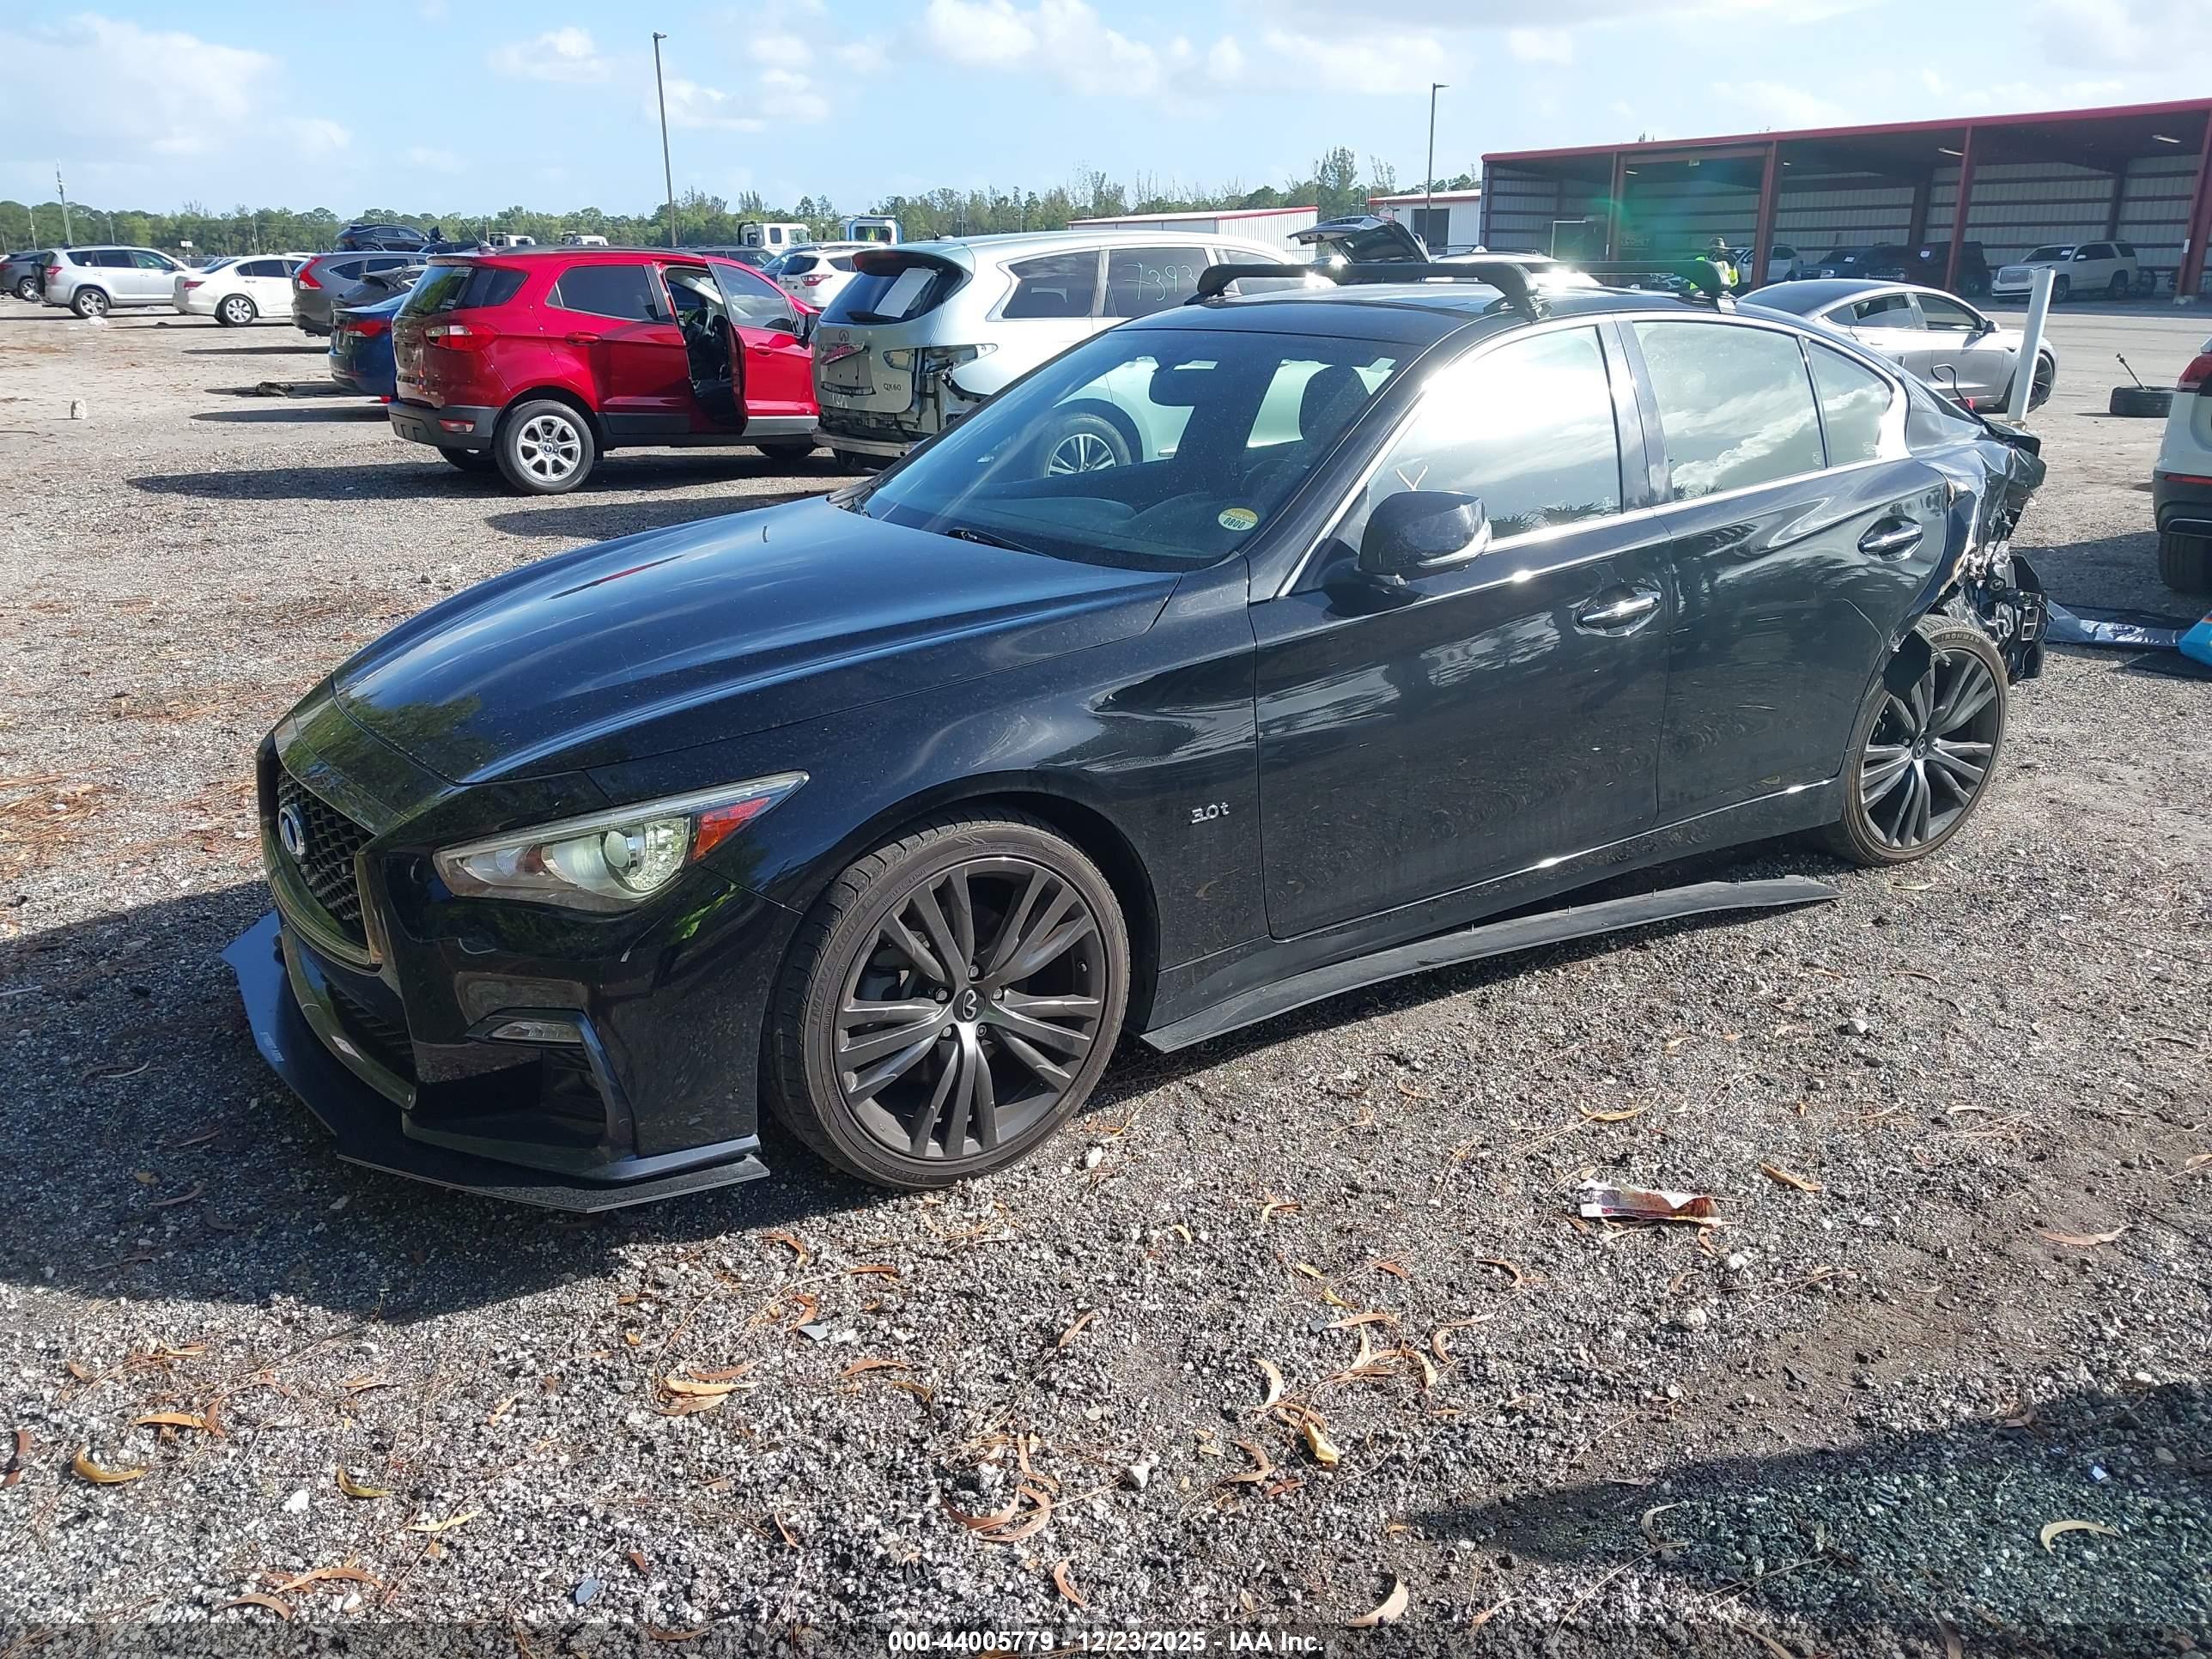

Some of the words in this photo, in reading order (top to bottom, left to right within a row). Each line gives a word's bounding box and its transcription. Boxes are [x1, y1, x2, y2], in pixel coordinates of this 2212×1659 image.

[883, 383, 902, 392] QX60
[1223, 517, 1246, 529] 0800
[1941, 633, 1981, 645] IRONMAN
